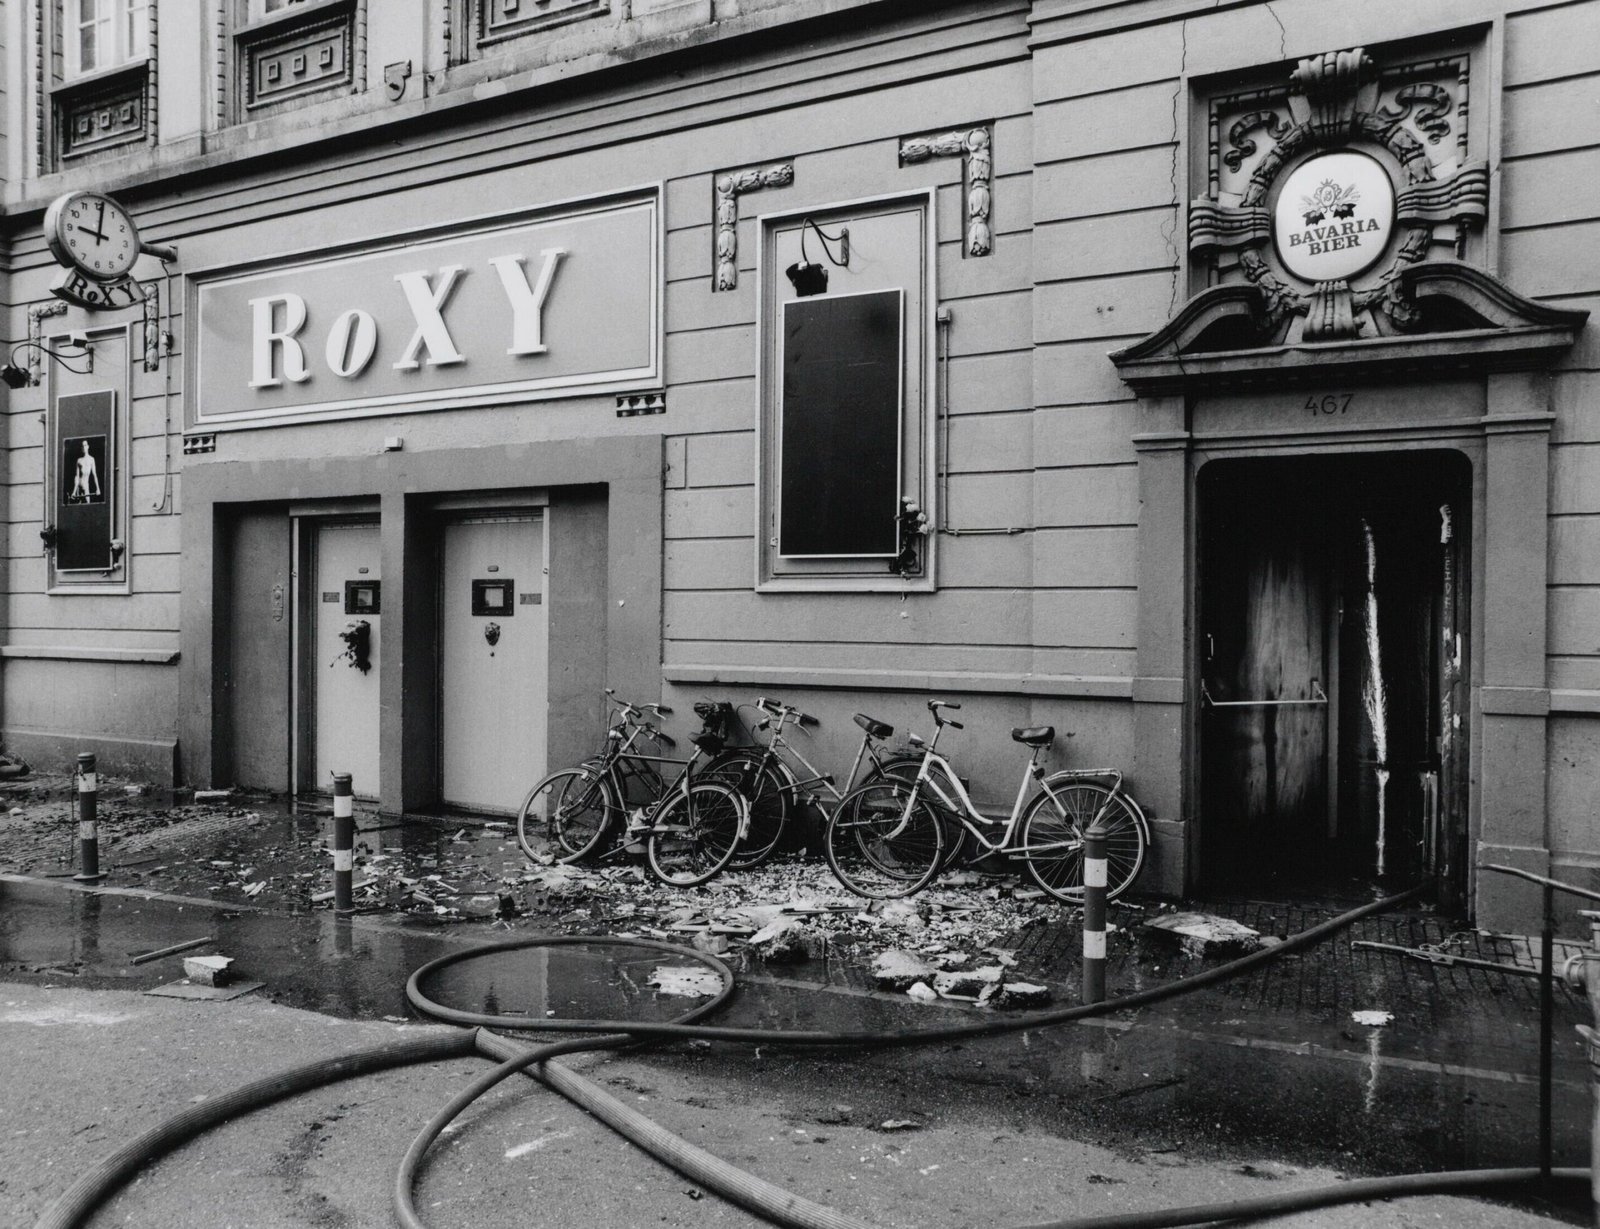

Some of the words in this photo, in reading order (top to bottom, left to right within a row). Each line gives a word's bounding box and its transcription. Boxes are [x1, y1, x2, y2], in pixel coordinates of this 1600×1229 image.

[81, 202, 88, 210] 11
[71, 209, 80, 218] 10
[66, 223, 73, 231] 9
[119, 224, 126, 233] 2
[1289, 218, 1380, 247] BAVARIA
[70, 239, 76, 247] 8
[1308, 234, 1362, 256] BIER
[81, 253, 87, 261] 7
[118, 253, 124, 261] 4
[108, 261, 114, 269] 5
[1304, 393, 1354, 416] 467
